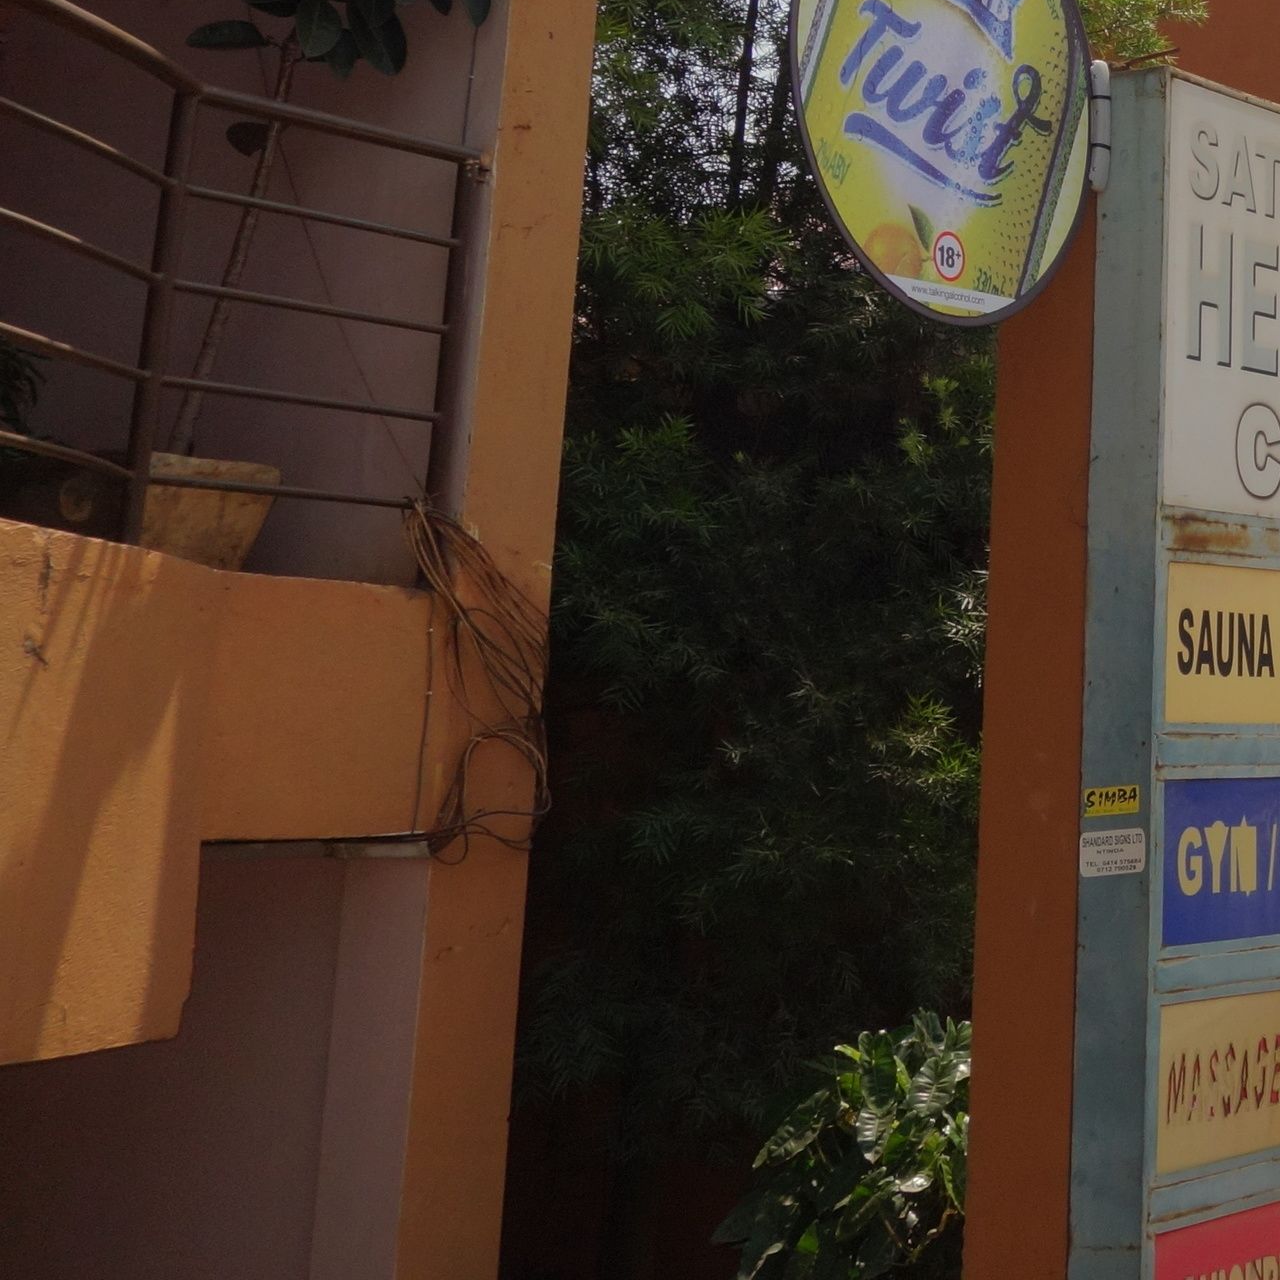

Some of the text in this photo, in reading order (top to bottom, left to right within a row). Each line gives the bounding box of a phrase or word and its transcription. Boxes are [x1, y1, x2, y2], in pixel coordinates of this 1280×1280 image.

[938, 244, 962, 269] 18+
[1177, 607, 1275, 679] SAUNA
[1086, 787, 1138, 808] SIMBA
